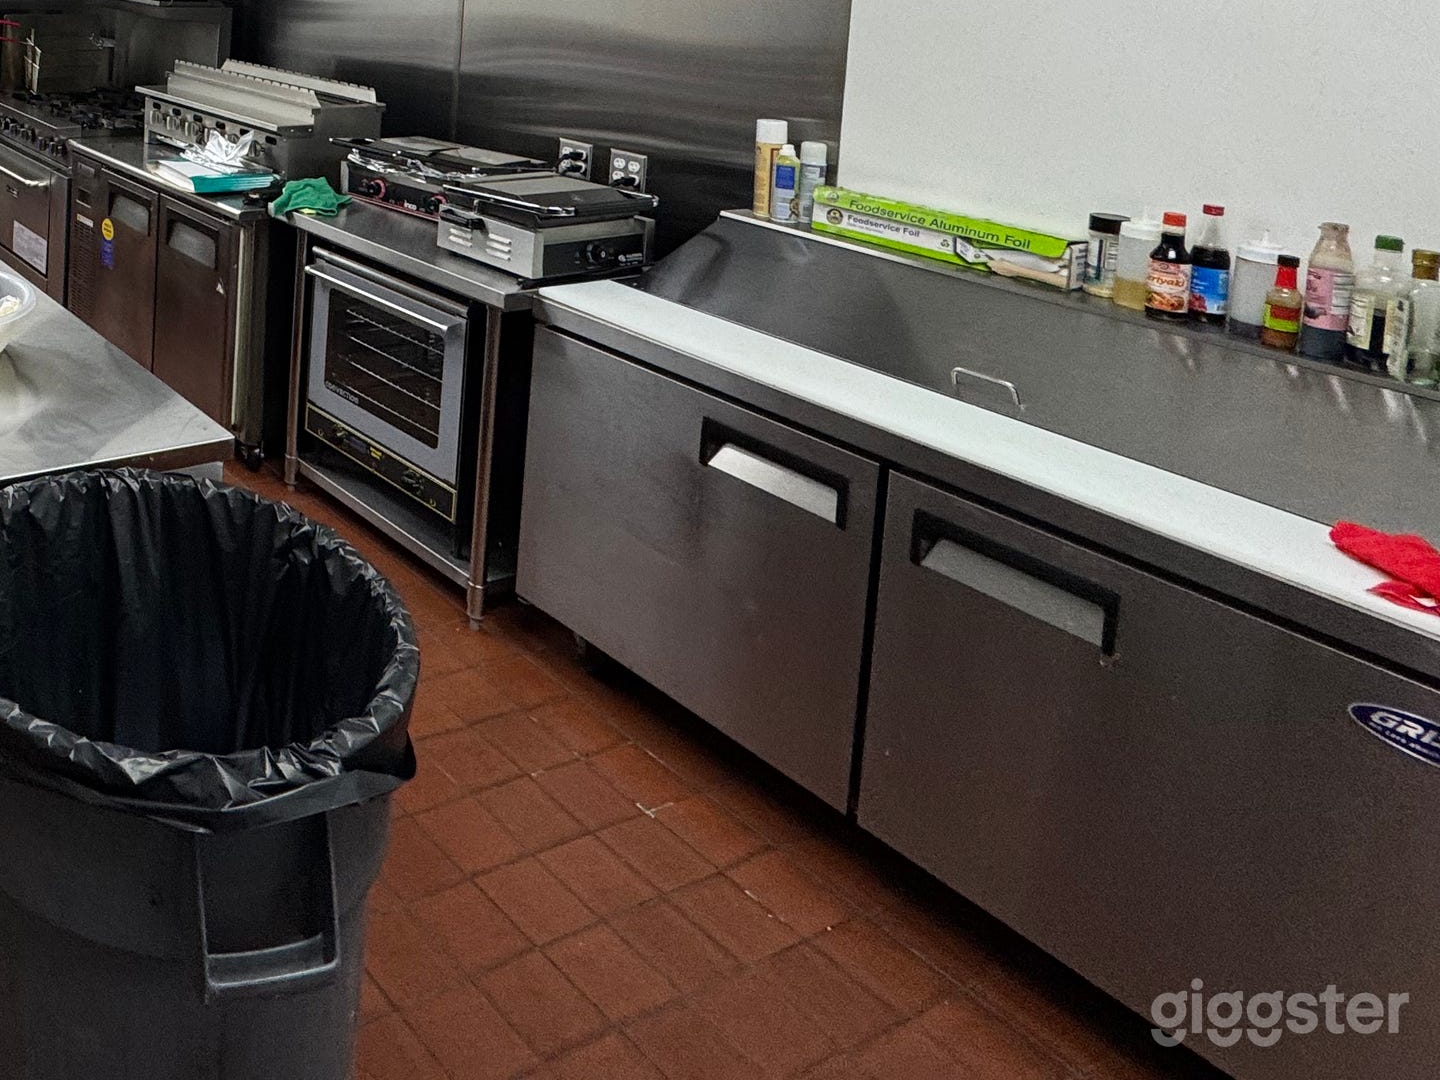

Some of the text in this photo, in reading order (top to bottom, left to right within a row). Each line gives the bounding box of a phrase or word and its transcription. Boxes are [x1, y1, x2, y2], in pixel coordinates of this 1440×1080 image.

[847, 214, 901, 233] Foodservice
[903, 227, 920, 237] Foil
[849, 200, 1031, 249] Foodservice Aluminum Foil
[1148, 275, 1185, 287] eriyaki
